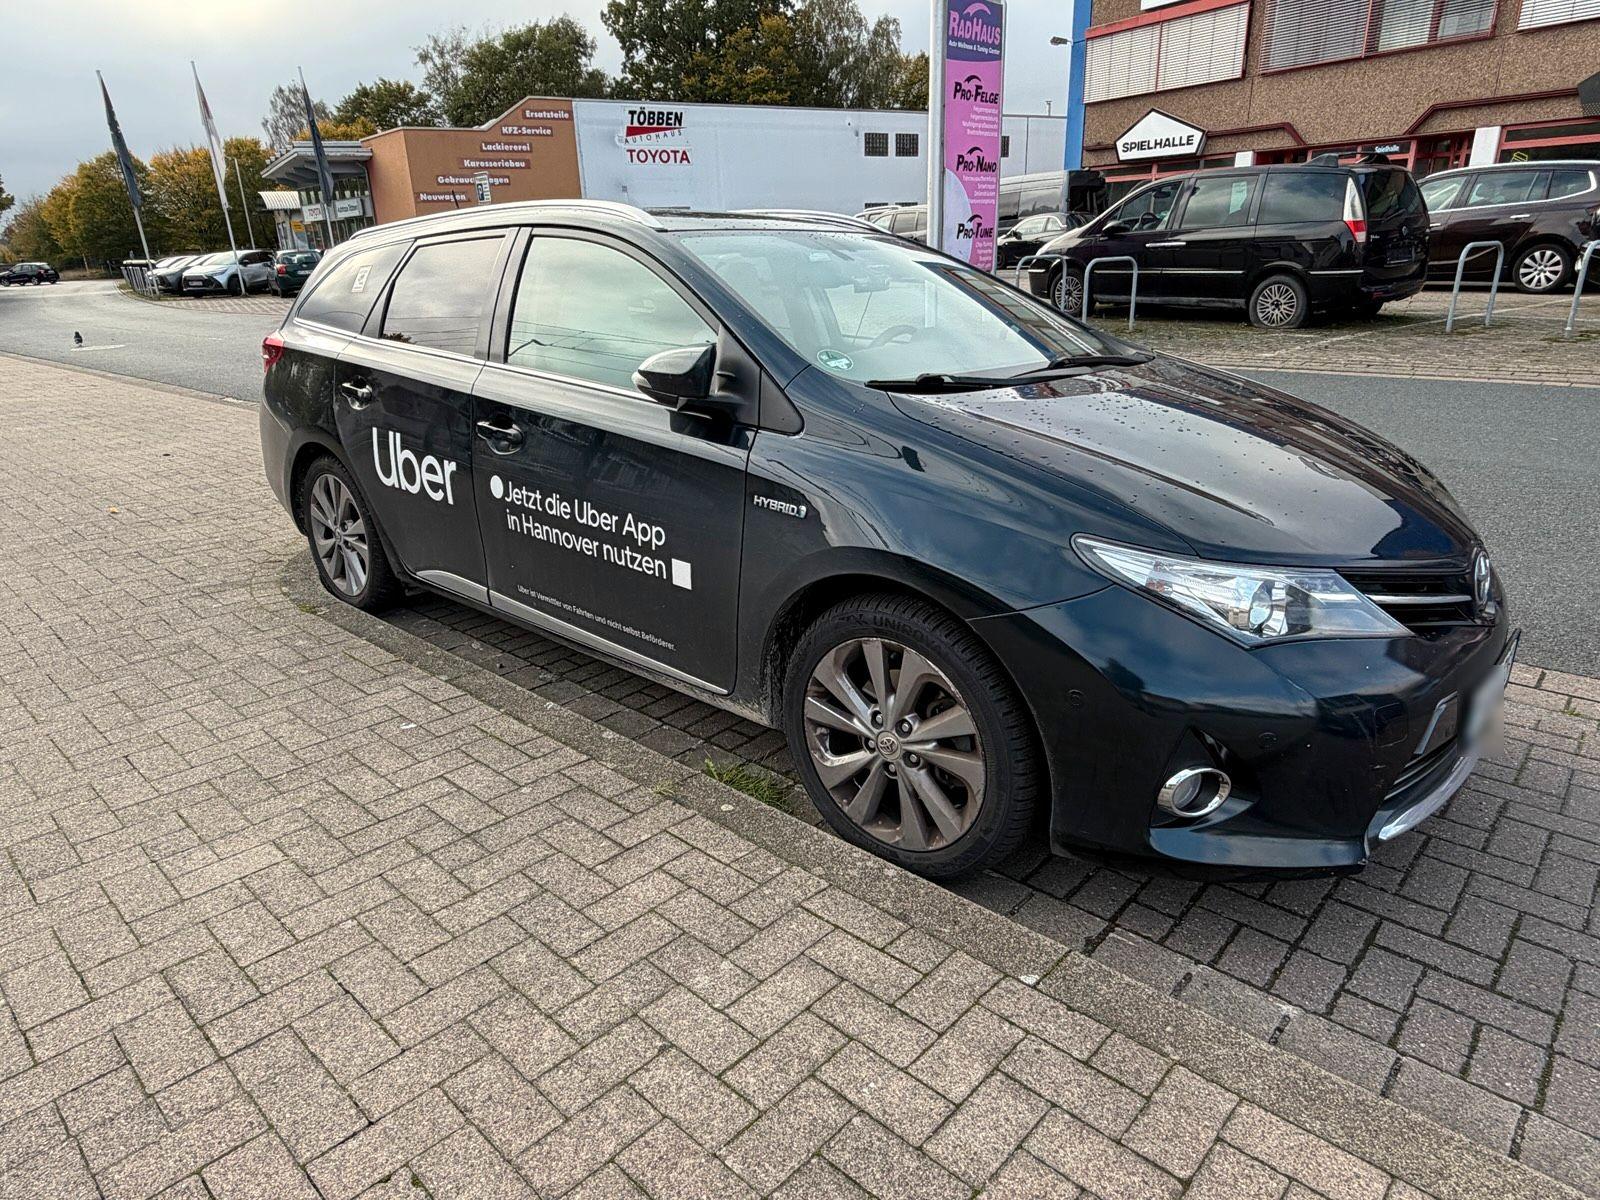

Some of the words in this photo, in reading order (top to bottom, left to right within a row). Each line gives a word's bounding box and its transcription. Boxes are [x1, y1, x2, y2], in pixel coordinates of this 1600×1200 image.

[525, 110, 570, 120] Ersatzteile
[628, 106, 684, 127] TÖBBEN
[502, 126, 552, 136] KFZ-Service
[624, 131, 683, 145] AUTOHAUS
[481, 142, 531, 152] Lackiererei
[1122, 134, 1195, 153] SPIELHALLE
[463, 159, 526, 169] Karosseriebau
[626, 149, 691, 164] TOYOTA
[419, 193, 467, 202] Neuwagen
[372, 426, 457, 505] Uber
[753, 494, 798, 517] HYBRID
[504, 481, 542, 512] Jetzt
[545, 492, 571, 519] die
[575, 499, 619, 533] Uber
[622, 512, 667, 551] App
[506, 508, 521, 533] in
[522, 512, 600, 559] Hannover
[602, 543, 667, 580] nutzen
